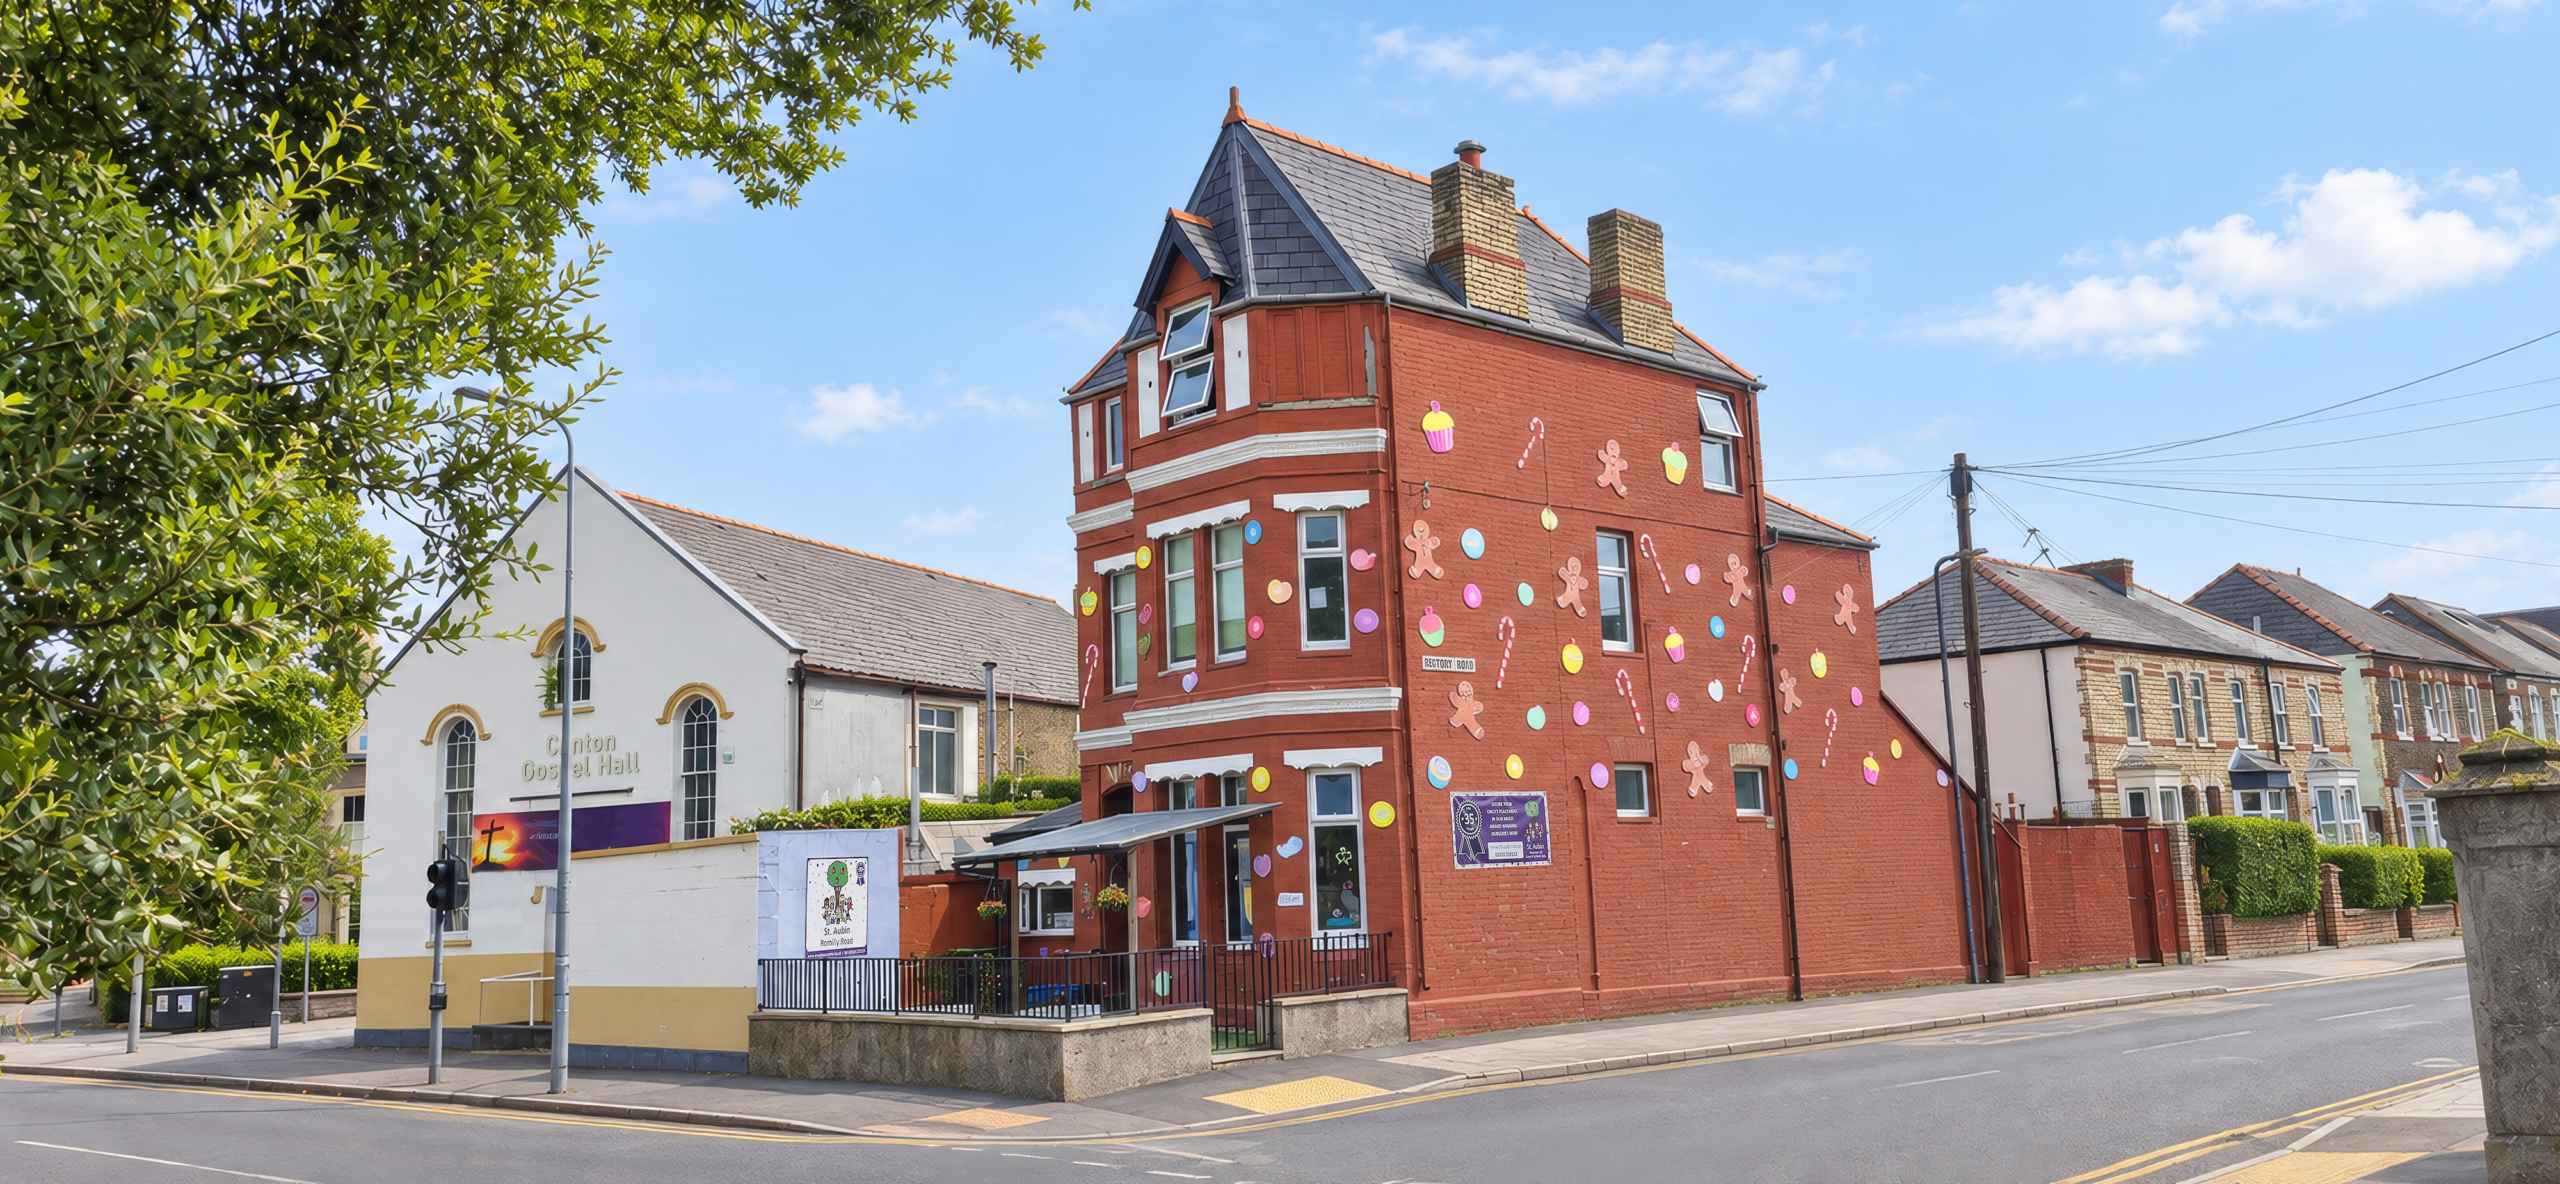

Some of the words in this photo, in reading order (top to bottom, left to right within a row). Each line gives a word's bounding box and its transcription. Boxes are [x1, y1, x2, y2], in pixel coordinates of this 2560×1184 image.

[1424, 658, 1453, 669] RECTORY
[1456, 660, 1474, 670] ROAD
[546, 733, 616, 756] Cnton
[521, 756, 591, 788] Gosel
[598, 751, 640, 776] Hall
[1464, 813, 1475, 825] 35
[1532, 842, 1545, 850] Aubin
[823, 927, 832, 935] St.
[833, 926, 851, 935] Aubin
[820, 938, 840, 947] Romilly
[840, 937, 854, 946] Road
